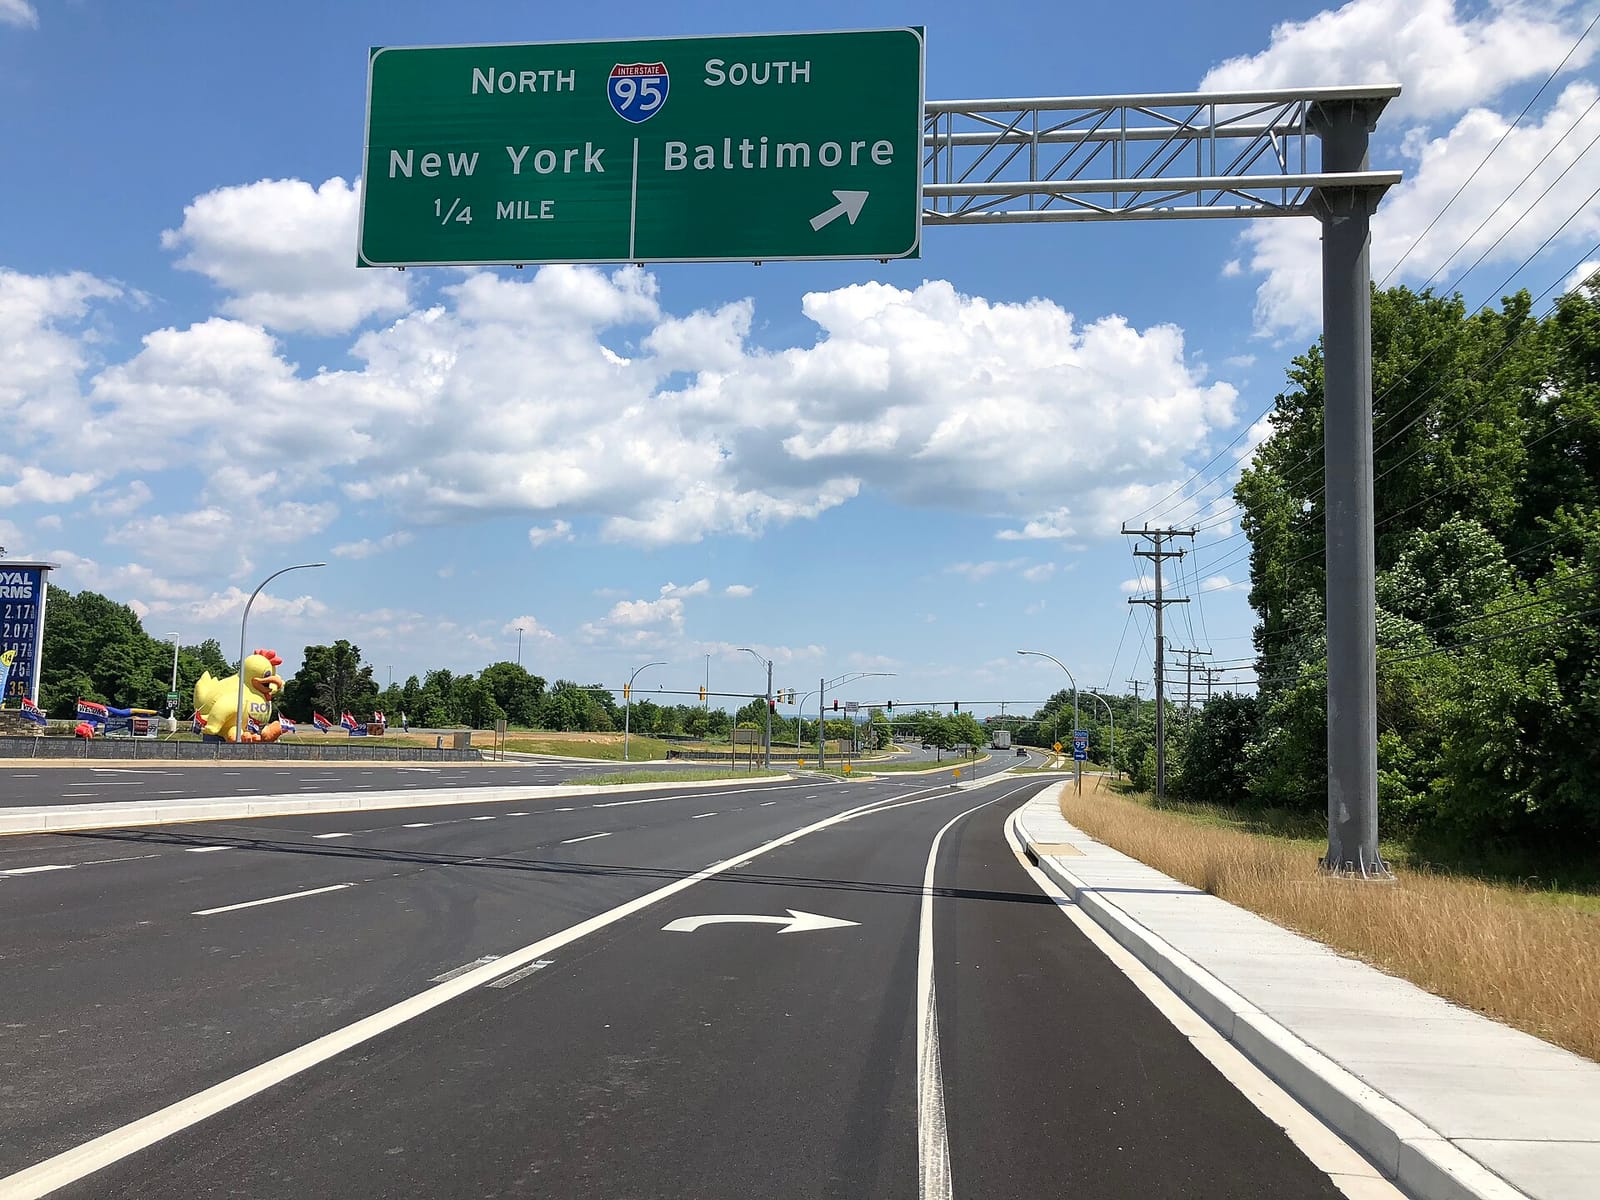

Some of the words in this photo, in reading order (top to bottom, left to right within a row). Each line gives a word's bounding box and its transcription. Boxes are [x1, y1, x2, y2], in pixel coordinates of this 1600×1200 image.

[471, 67, 576, 94] NORTH
[617, 63, 661, 76] INTERSTATE
[704, 58, 811, 87] SOUTH
[614, 76, 663, 111] 95
[388, 149, 479, 178] New
[506, 142, 606, 175] York
[664, 136, 895, 171] Baltimore
[434, 197, 473, 225] 1/4
[496, 200, 555, 221] MILE
